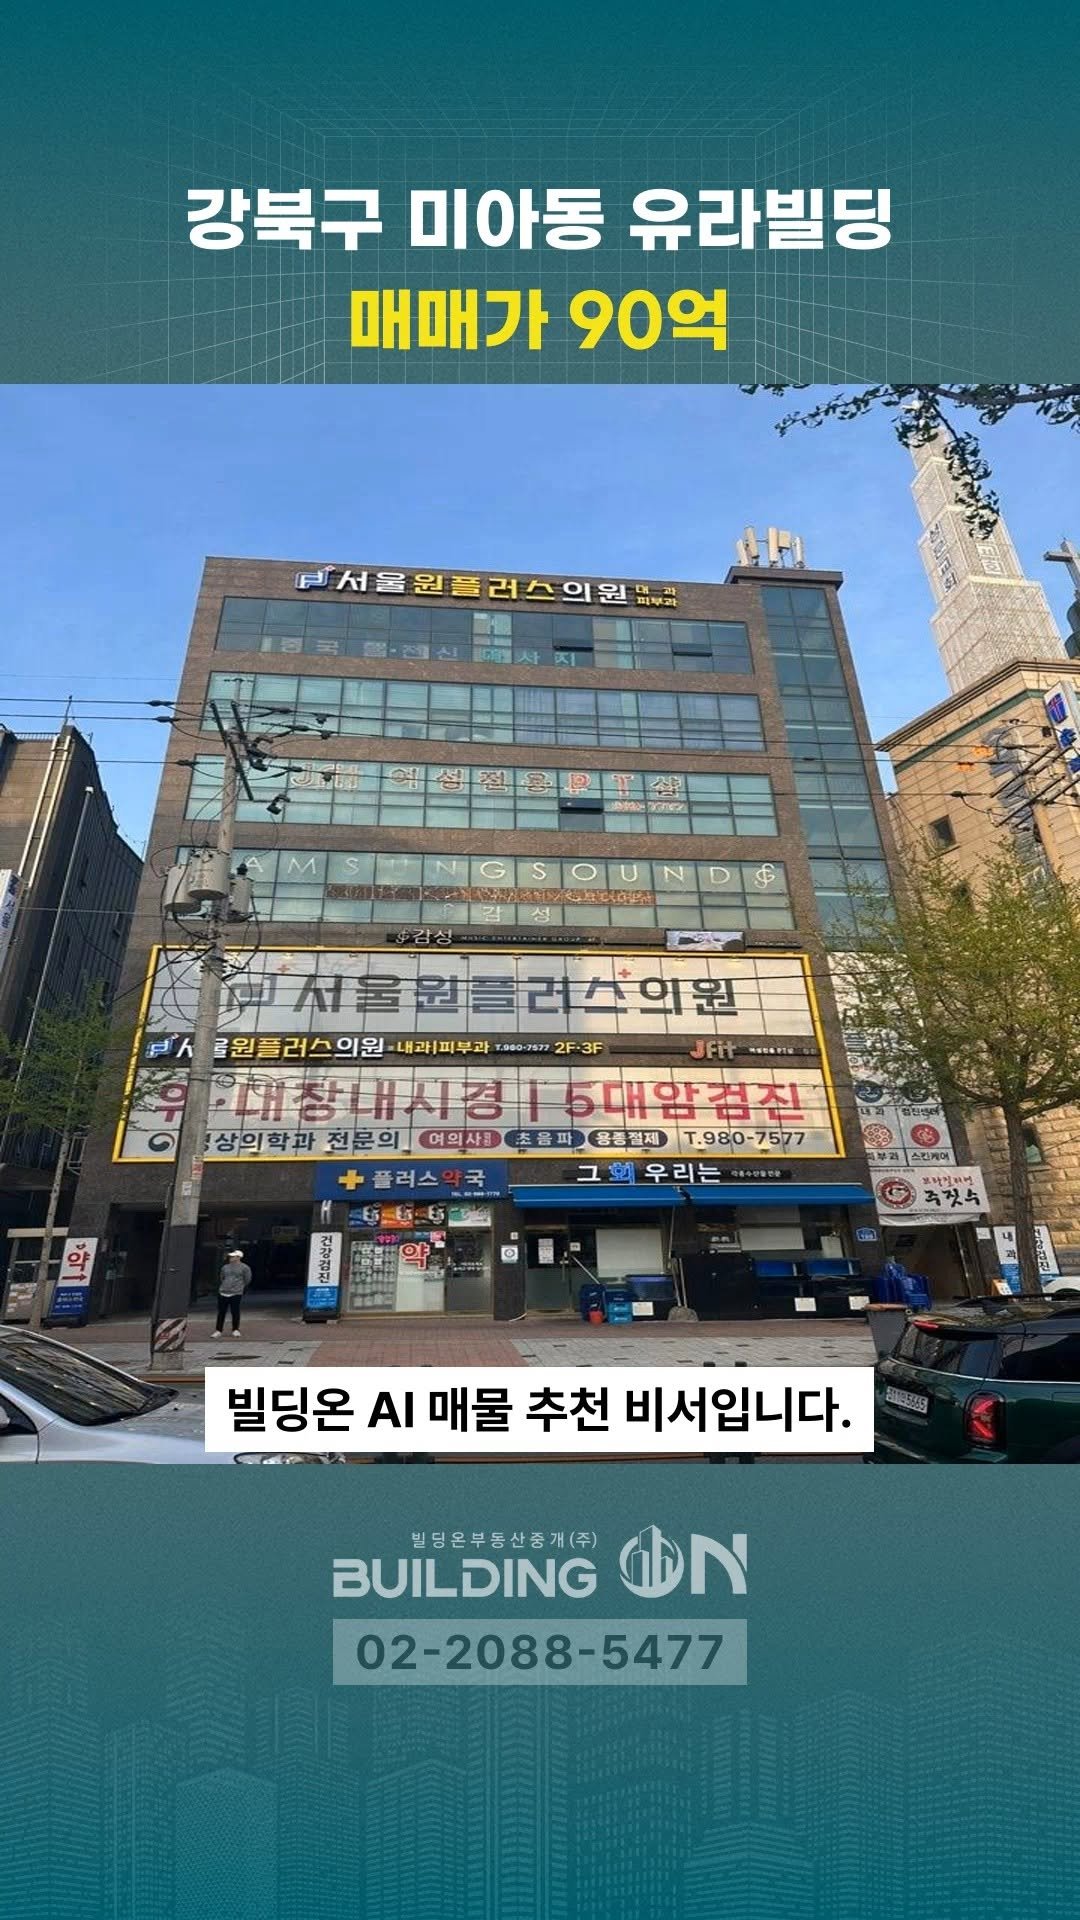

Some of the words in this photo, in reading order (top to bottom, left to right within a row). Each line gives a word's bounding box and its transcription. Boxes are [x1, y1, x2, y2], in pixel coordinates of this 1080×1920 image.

[335, 570, 628, 605] 서울원플러스의원
[636, 597, 677, 607] 피부과
[482, 904, 550, 923] 감성
[413, 929, 453, 945] 감성
[293, 973, 739, 1016] 서울원플러스의원
[495, 1043, 550, 1052] T.980-7577
[564, 1080, 806, 1122] 5대암검진
[205, 1131, 316, 1152] 상의학과
[328, 1131, 400, 1151] 전문의
[428, 1131, 481, 1146] 여의사
[516, 1131, 573, 1146] 초음파
[595, 1130, 661, 1146] 용종절제
[684, 1131, 806, 1147] T.980-7577
[911, 1151, 950, 1161] 스킨케어
[372, 1168, 487, 1190] 플러스약국
[577, 1164, 601, 1182] 그
[644, 1163, 721, 1183] 우리는
[923, 1188, 981, 1208] 주짓수
[1002, 1231, 1017, 1259] 내과
[67, 1250, 91, 1272] 약
[318, 1235, 333, 1284] 건강검진
[399, 1241, 431, 1270] 약
